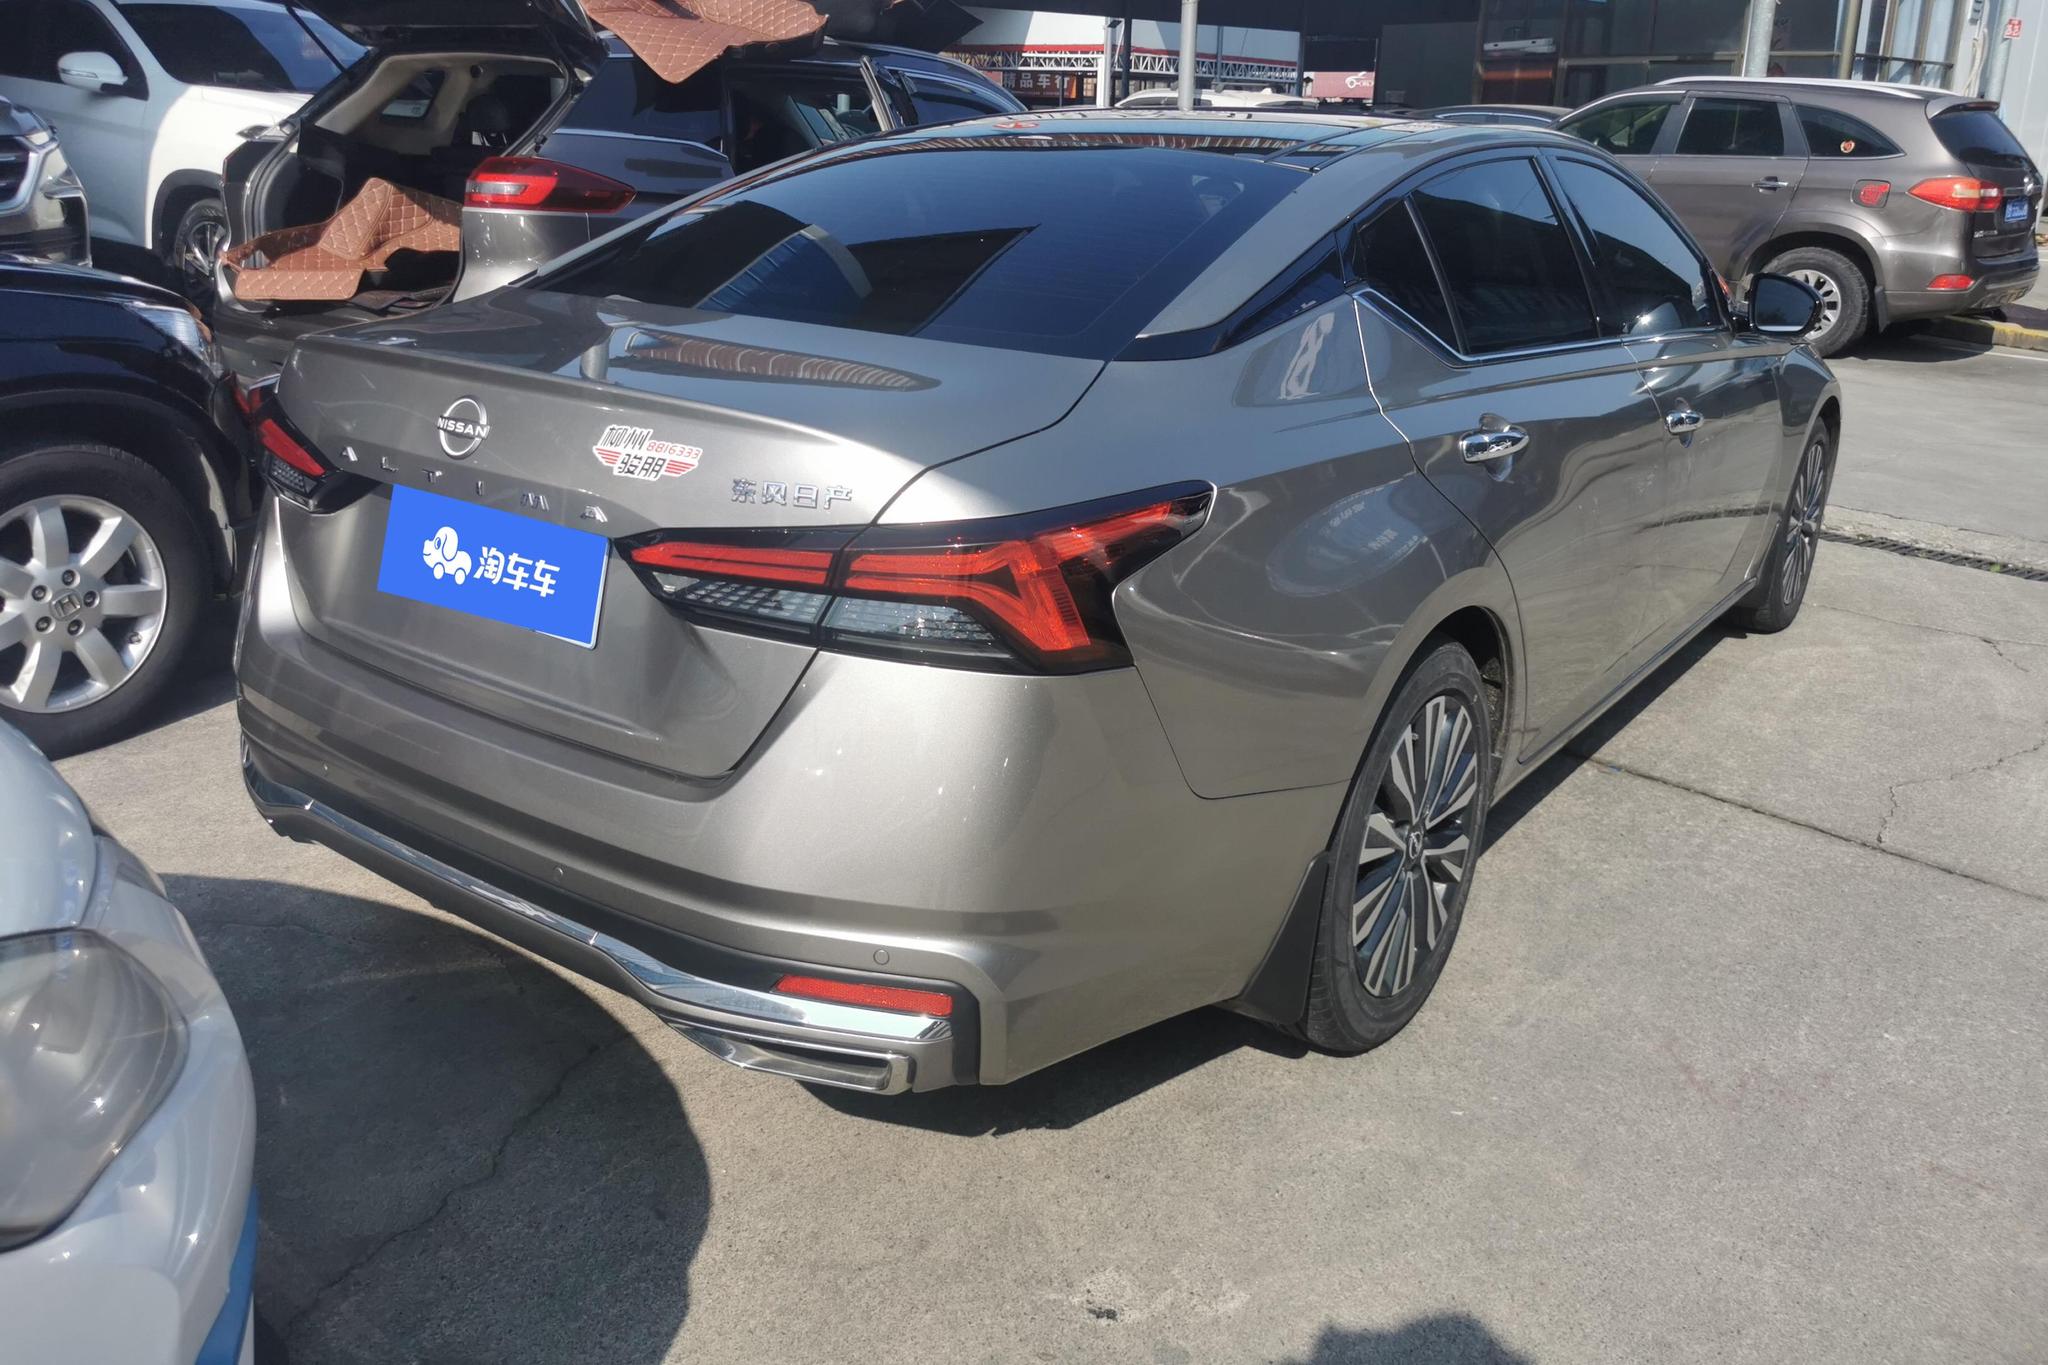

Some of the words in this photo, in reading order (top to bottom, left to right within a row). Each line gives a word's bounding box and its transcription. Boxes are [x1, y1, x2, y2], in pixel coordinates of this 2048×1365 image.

[437, 417, 490, 439] NISSAN
[600, 427, 652, 451] 柳州
[646, 441, 701, 460] 8816333
[617, 453, 667, 478] 骏朋
[341, 446, 608, 523] ALTIMA
[731, 479, 853, 510] 东风日产
